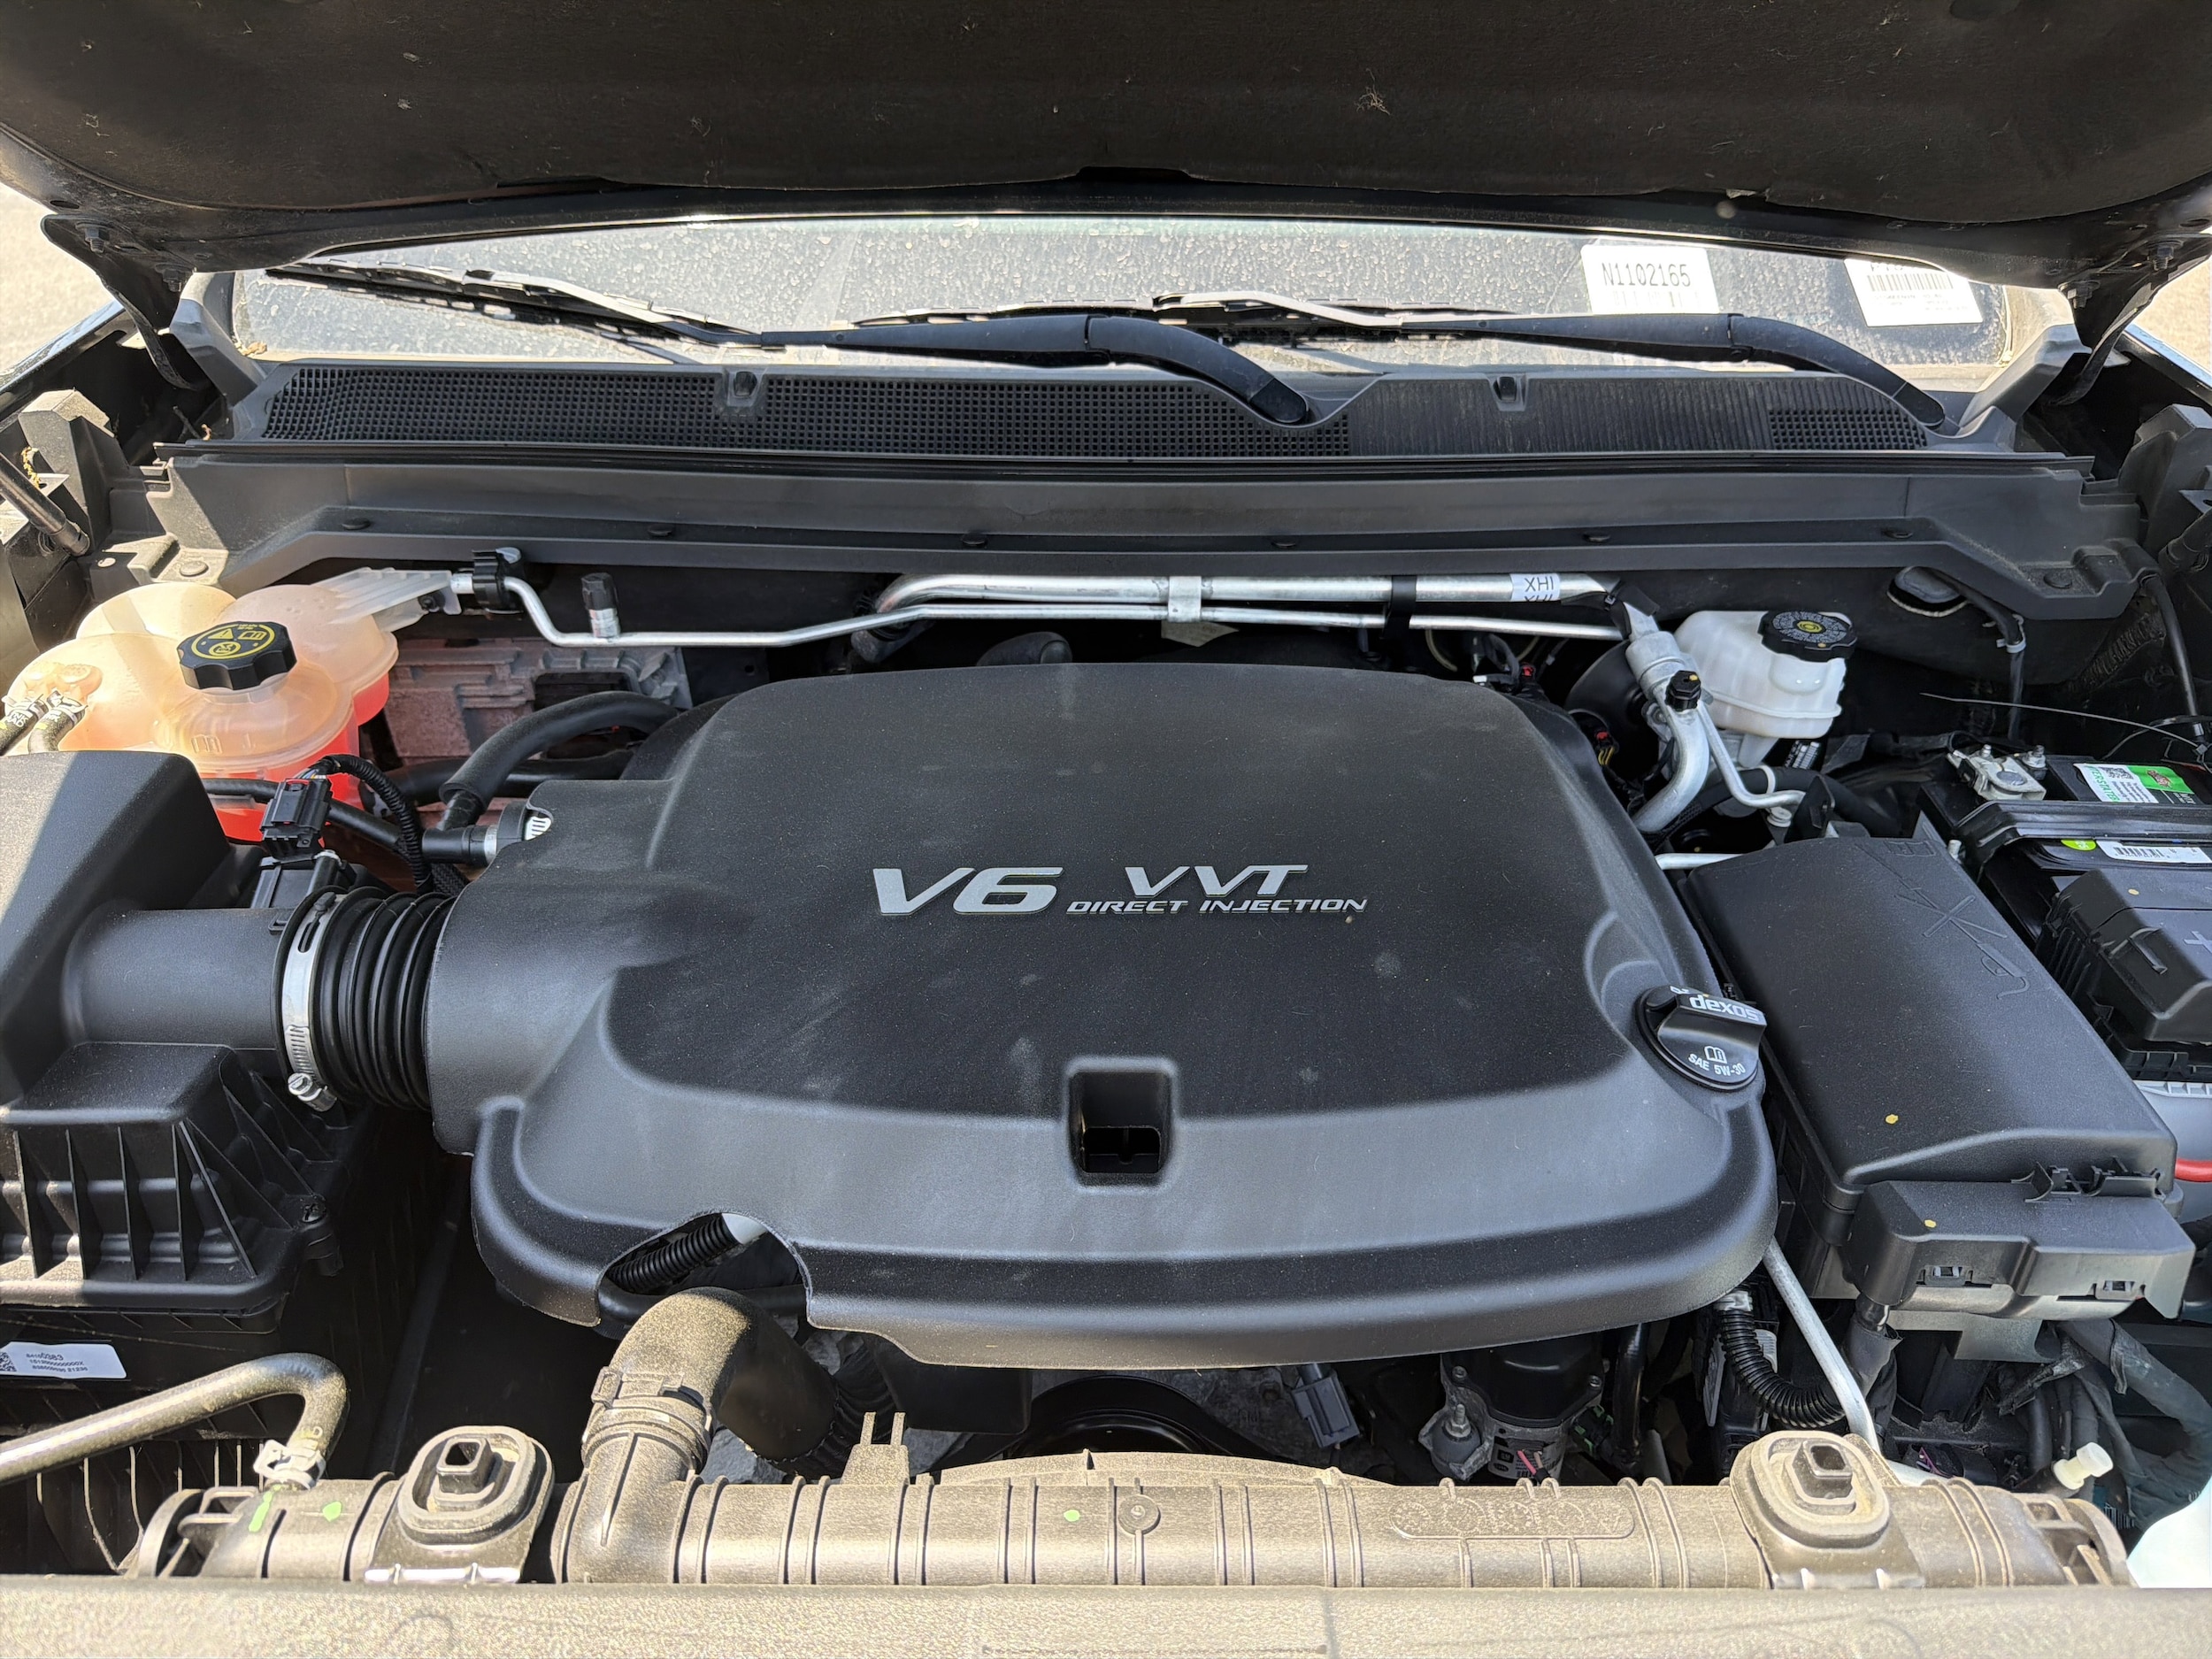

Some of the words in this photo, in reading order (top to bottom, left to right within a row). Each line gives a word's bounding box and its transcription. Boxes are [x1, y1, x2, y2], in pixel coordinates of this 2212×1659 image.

[1601, 262, 1691, 288] N1102165
[872, 866, 1064, 916] V6
[1125, 864, 1309, 898] VVT
[1065, 899, 1189, 914] DIRECT
[1198, 898, 1368, 914] INJECTION
[1689, 994, 1760, 1022] dexos
[1688, 1053, 1710, 1071] SAE
[1714, 1063, 1746, 1077] 5W-30
